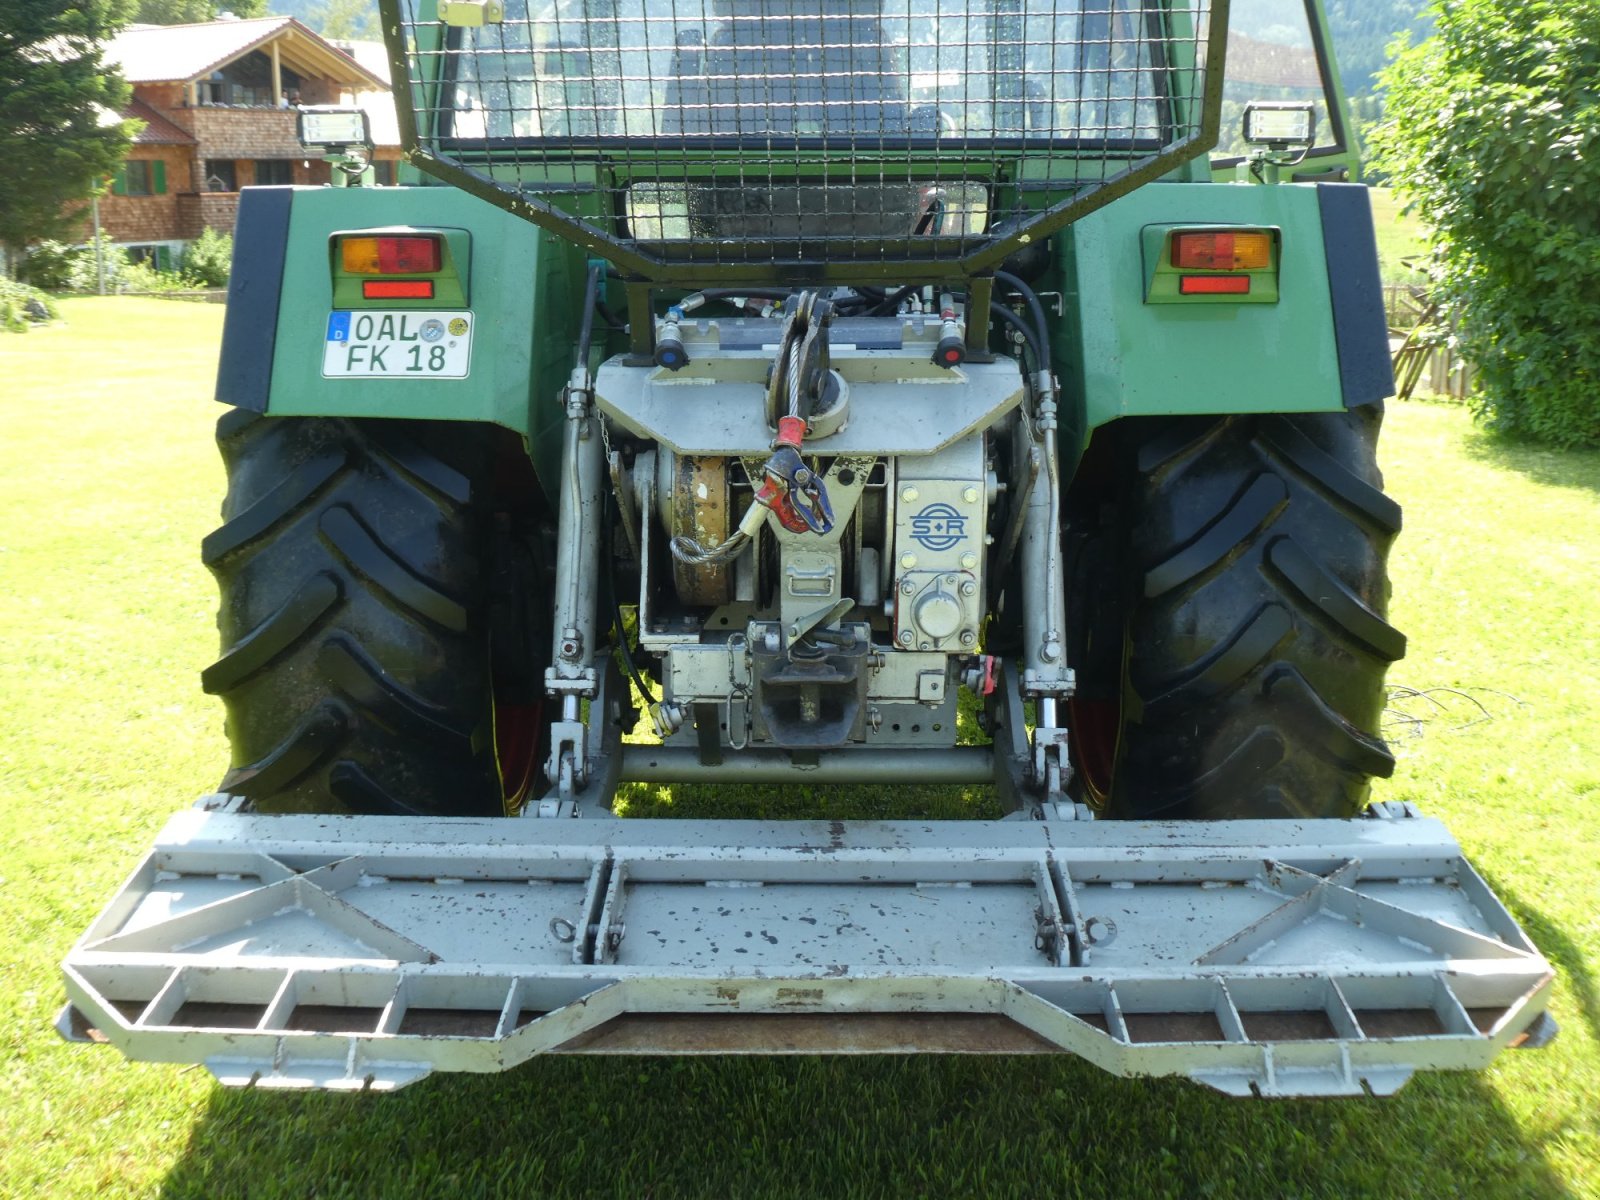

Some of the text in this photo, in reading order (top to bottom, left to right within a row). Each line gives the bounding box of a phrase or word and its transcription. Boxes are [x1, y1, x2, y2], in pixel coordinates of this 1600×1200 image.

[334, 330, 343, 339] D
[356, 315, 418, 341] OAL
[347, 345, 445, 371] FK 18
